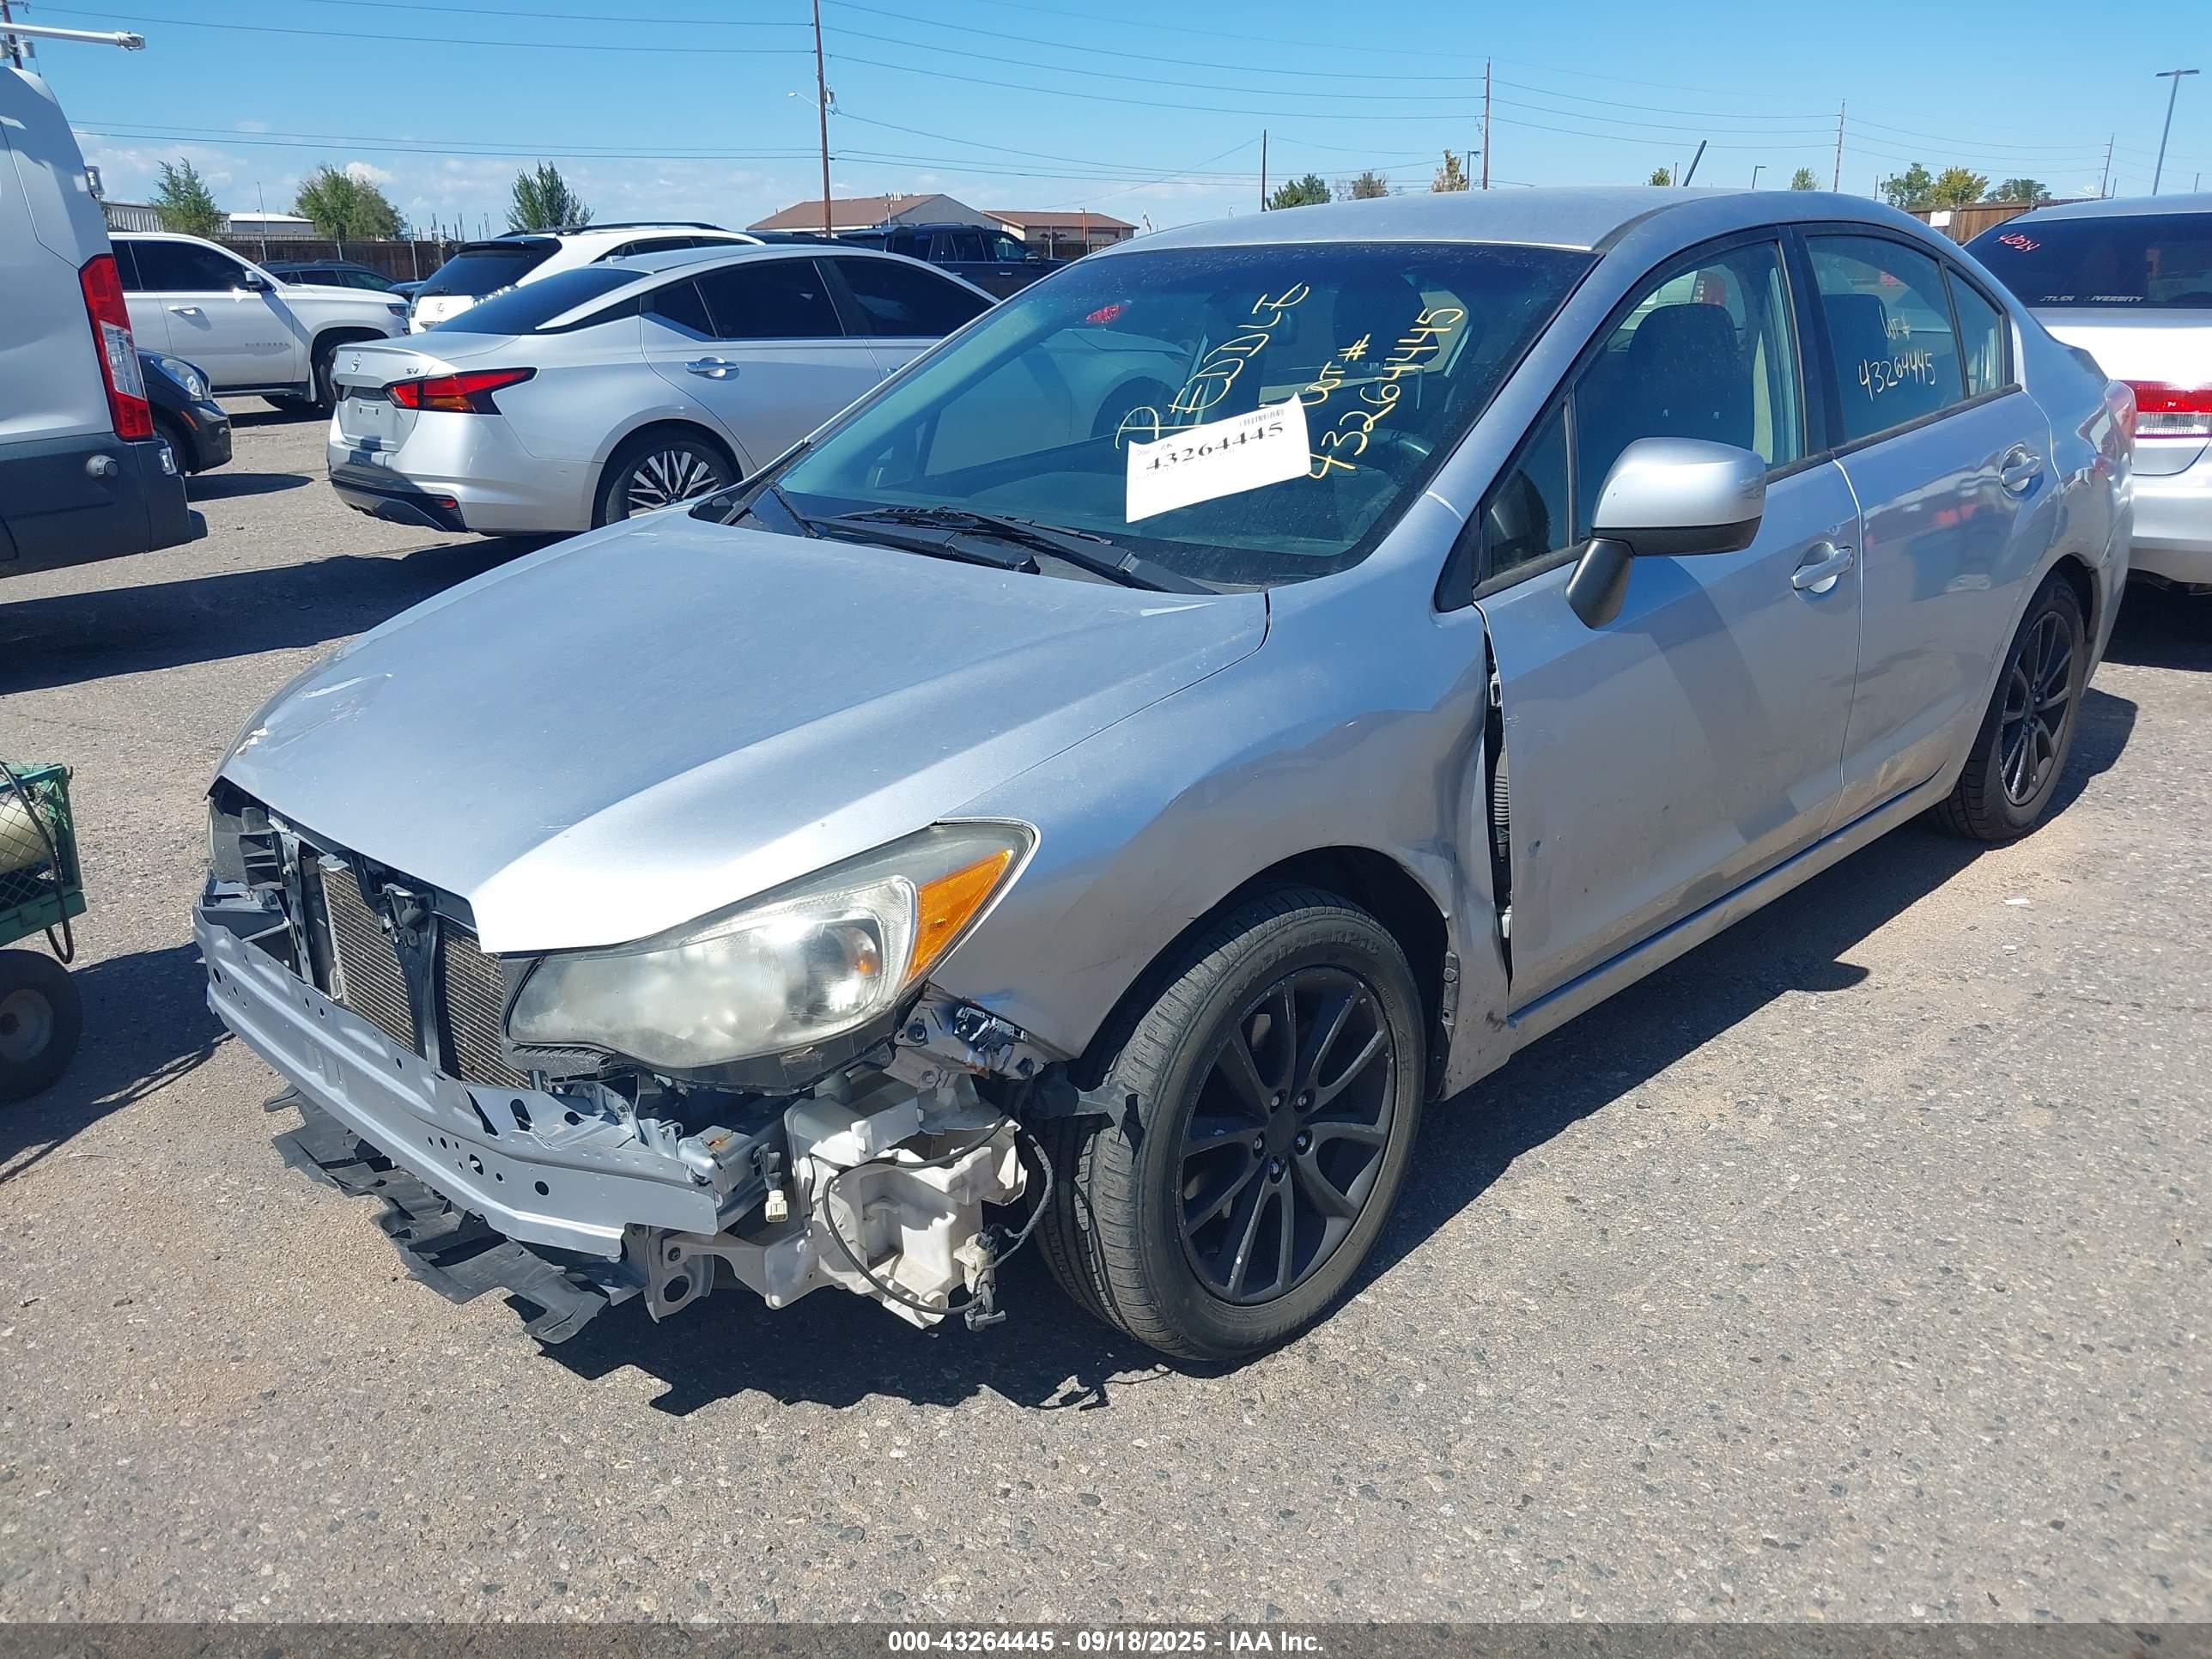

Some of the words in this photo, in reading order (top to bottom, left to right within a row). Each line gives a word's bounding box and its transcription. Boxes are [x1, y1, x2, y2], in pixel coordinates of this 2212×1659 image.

[1336, 333, 1371, 363] #
[1308, 307, 1463, 478] 43264445
[1858, 348, 1936, 402] 43264445
[1146, 422, 1284, 470] 43264445
